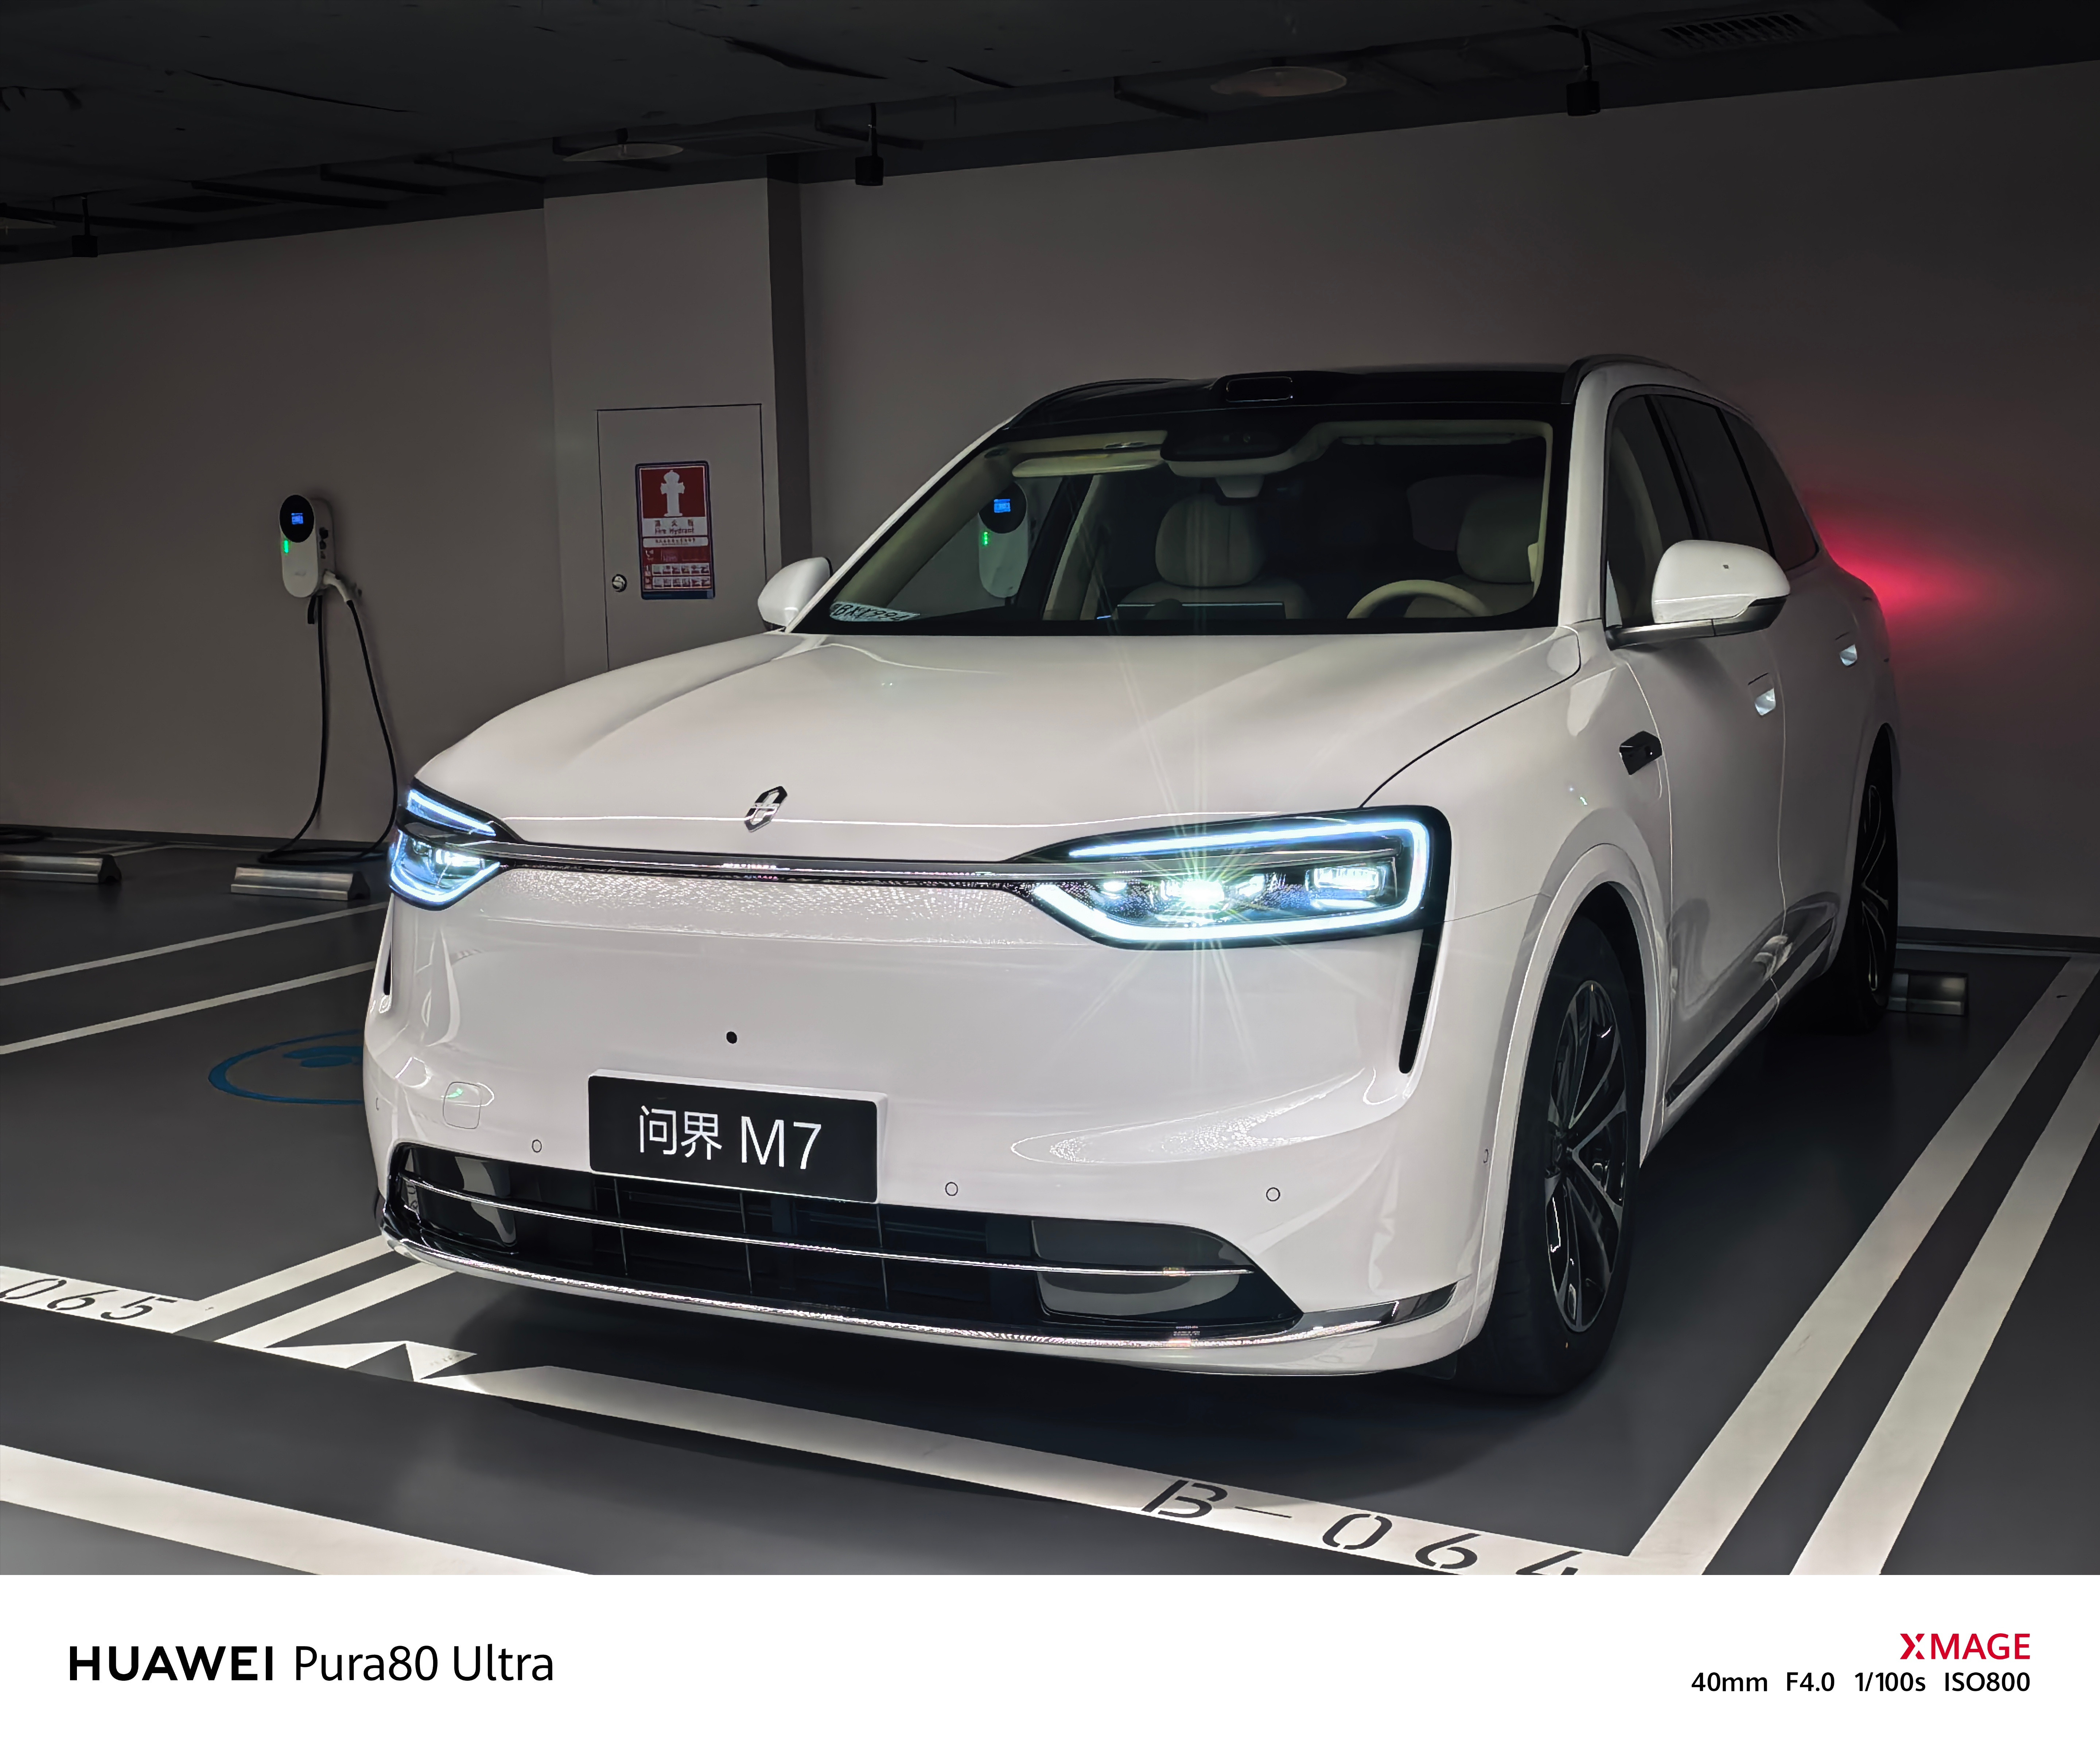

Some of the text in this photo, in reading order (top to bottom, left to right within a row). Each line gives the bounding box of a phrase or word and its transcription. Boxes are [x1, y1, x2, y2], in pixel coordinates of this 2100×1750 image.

[639, 1105, 822, 1170] 问界 M7
[0, 1279, 178, 1320] 065
